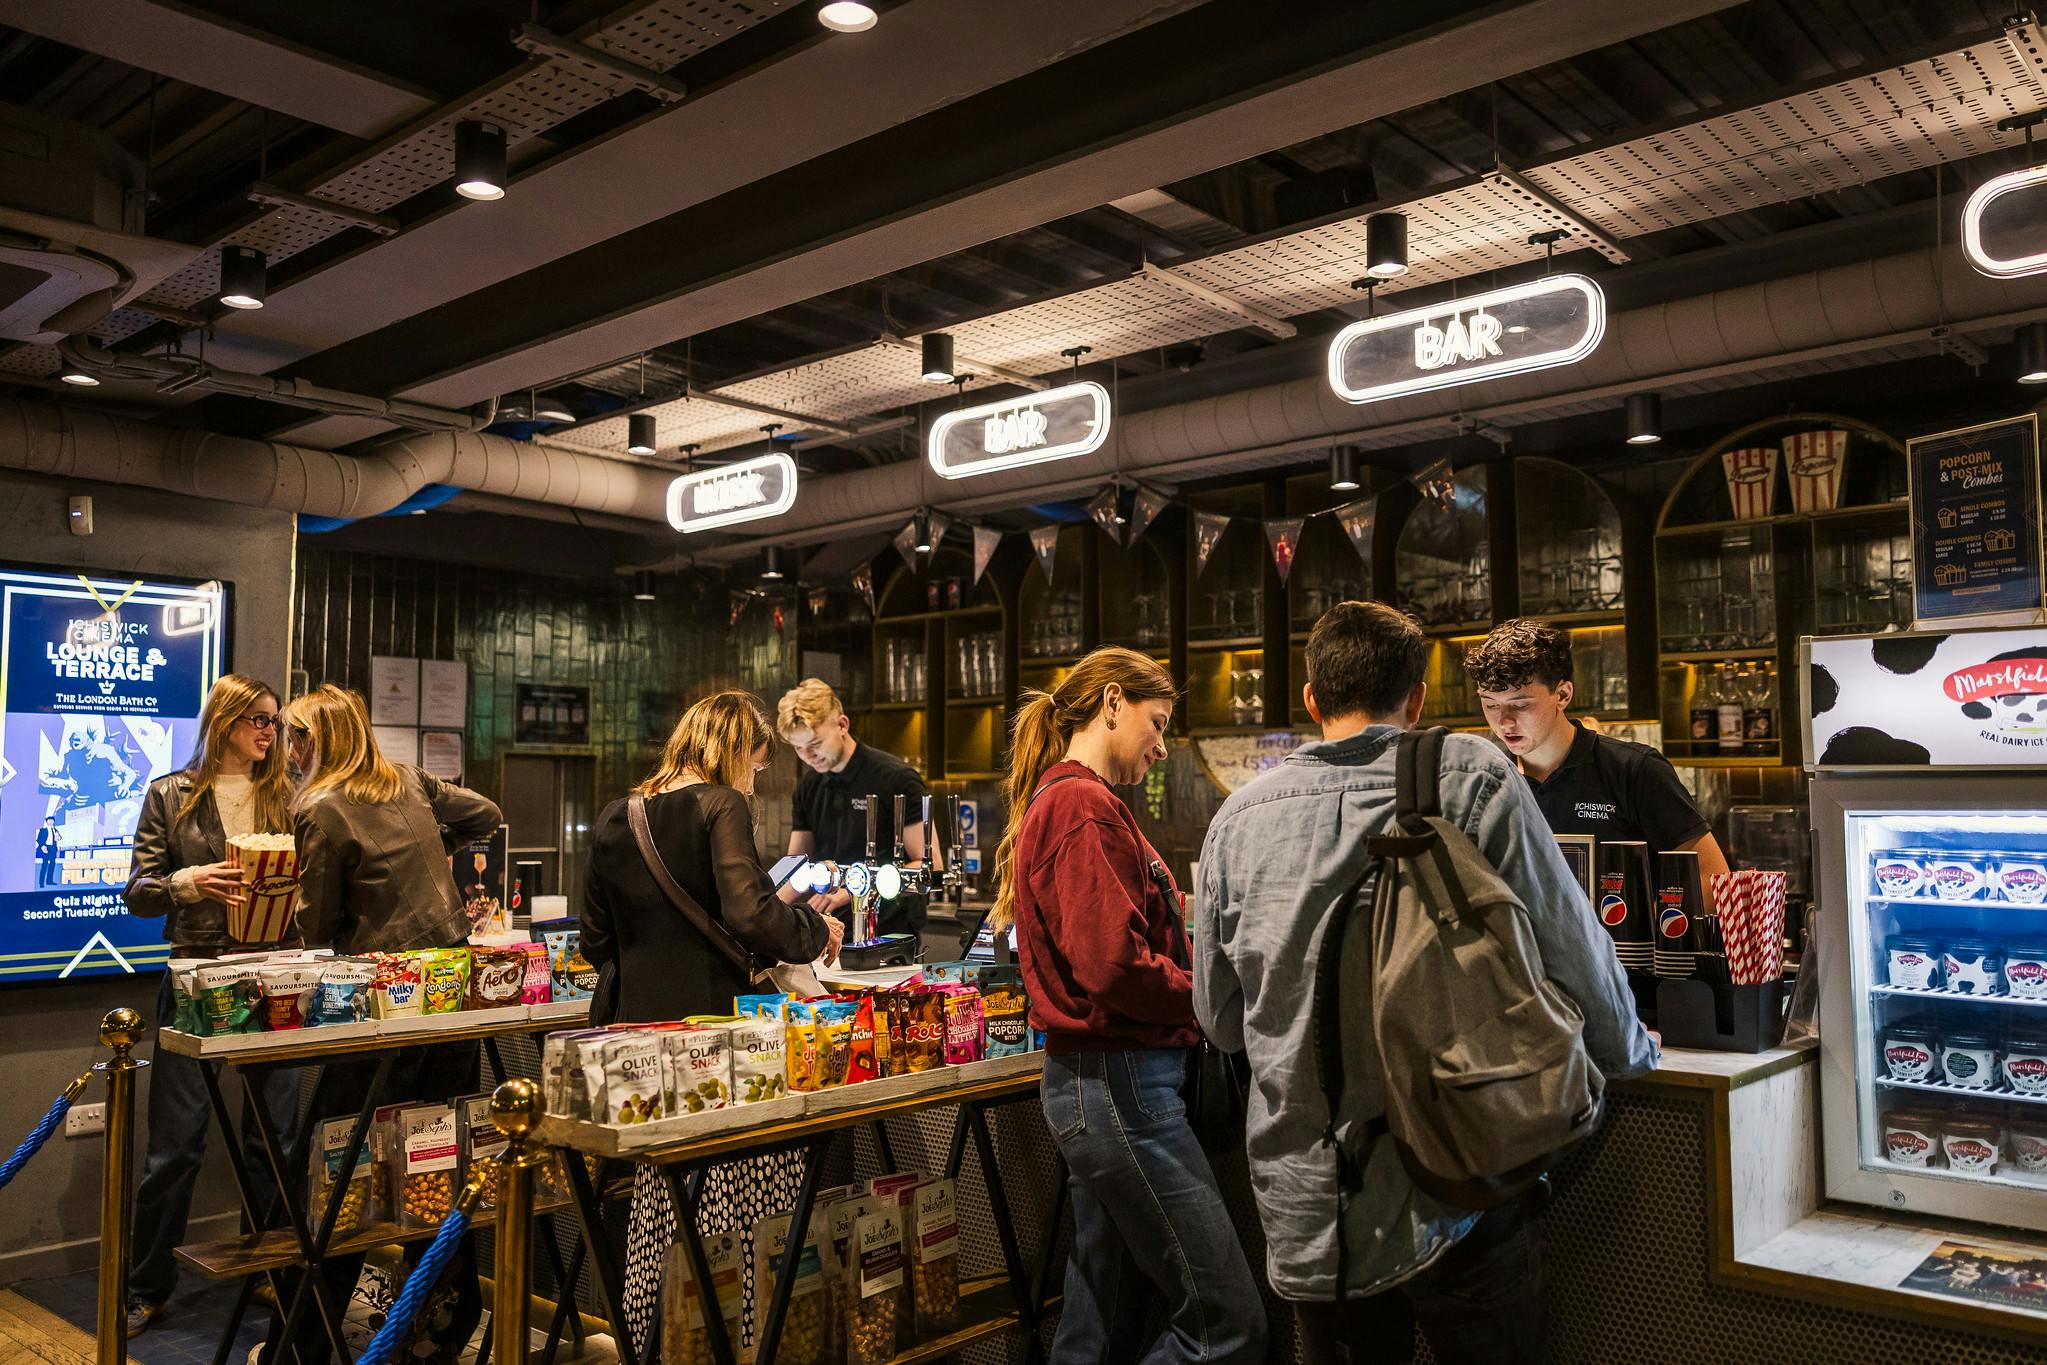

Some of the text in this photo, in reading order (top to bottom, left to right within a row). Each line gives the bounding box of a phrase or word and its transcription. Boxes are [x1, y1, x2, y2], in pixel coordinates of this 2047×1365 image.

[1414, 313, 1504, 369] BAR
[984, 410, 1048, 454] BAR
[1939, 451, 1991, 470] POPCORN
[1940, 461, 2003, 483] & POST-MIX
[1963, 471, 2003, 489] Combos
[46, 641, 168, 666] LOUNGE &
[51, 659, 154, 681] TERRACE
[56, 693, 76, 703] THE
[78, 694, 117, 705] LONDON
[119, 695, 143, 706] BATH
[1980, 729, 2044, 747] REAL DAIRY ICE
[1578, 802, 1616, 813] CHISWICK
[1577, 810, 1609, 820] CINEMA
[62, 867, 130, 886] FILM QUI
[54, 896, 80, 908] Quiz
[82, 894, 114, 907] Night
[23, 909, 62, 920] Second
[64, 906, 107, 918] Tuesday
[109, 906, 119, 915] of
[425, 978, 460, 994] Randoms
[483, 967, 522, 991] Aero
[388, 984, 414, 996] Milky
[394, 994, 410, 1004] bar
[986, 999, 1000, 1008] JOE
[689, 1044, 721, 1060] OLIVE
[747, 1040, 780, 1053] OLIVE
[621, 1055, 657, 1071] OLIVE
[690, 1056, 721, 1070] SNACK
[749, 1051, 782, 1064] SNACK
[623, 1067, 659, 1082] SNACK
[411, 1126, 424, 1135] JOE
[328, 1134, 342, 1144] JOE
[864, 1233, 876, 1245] JOE
